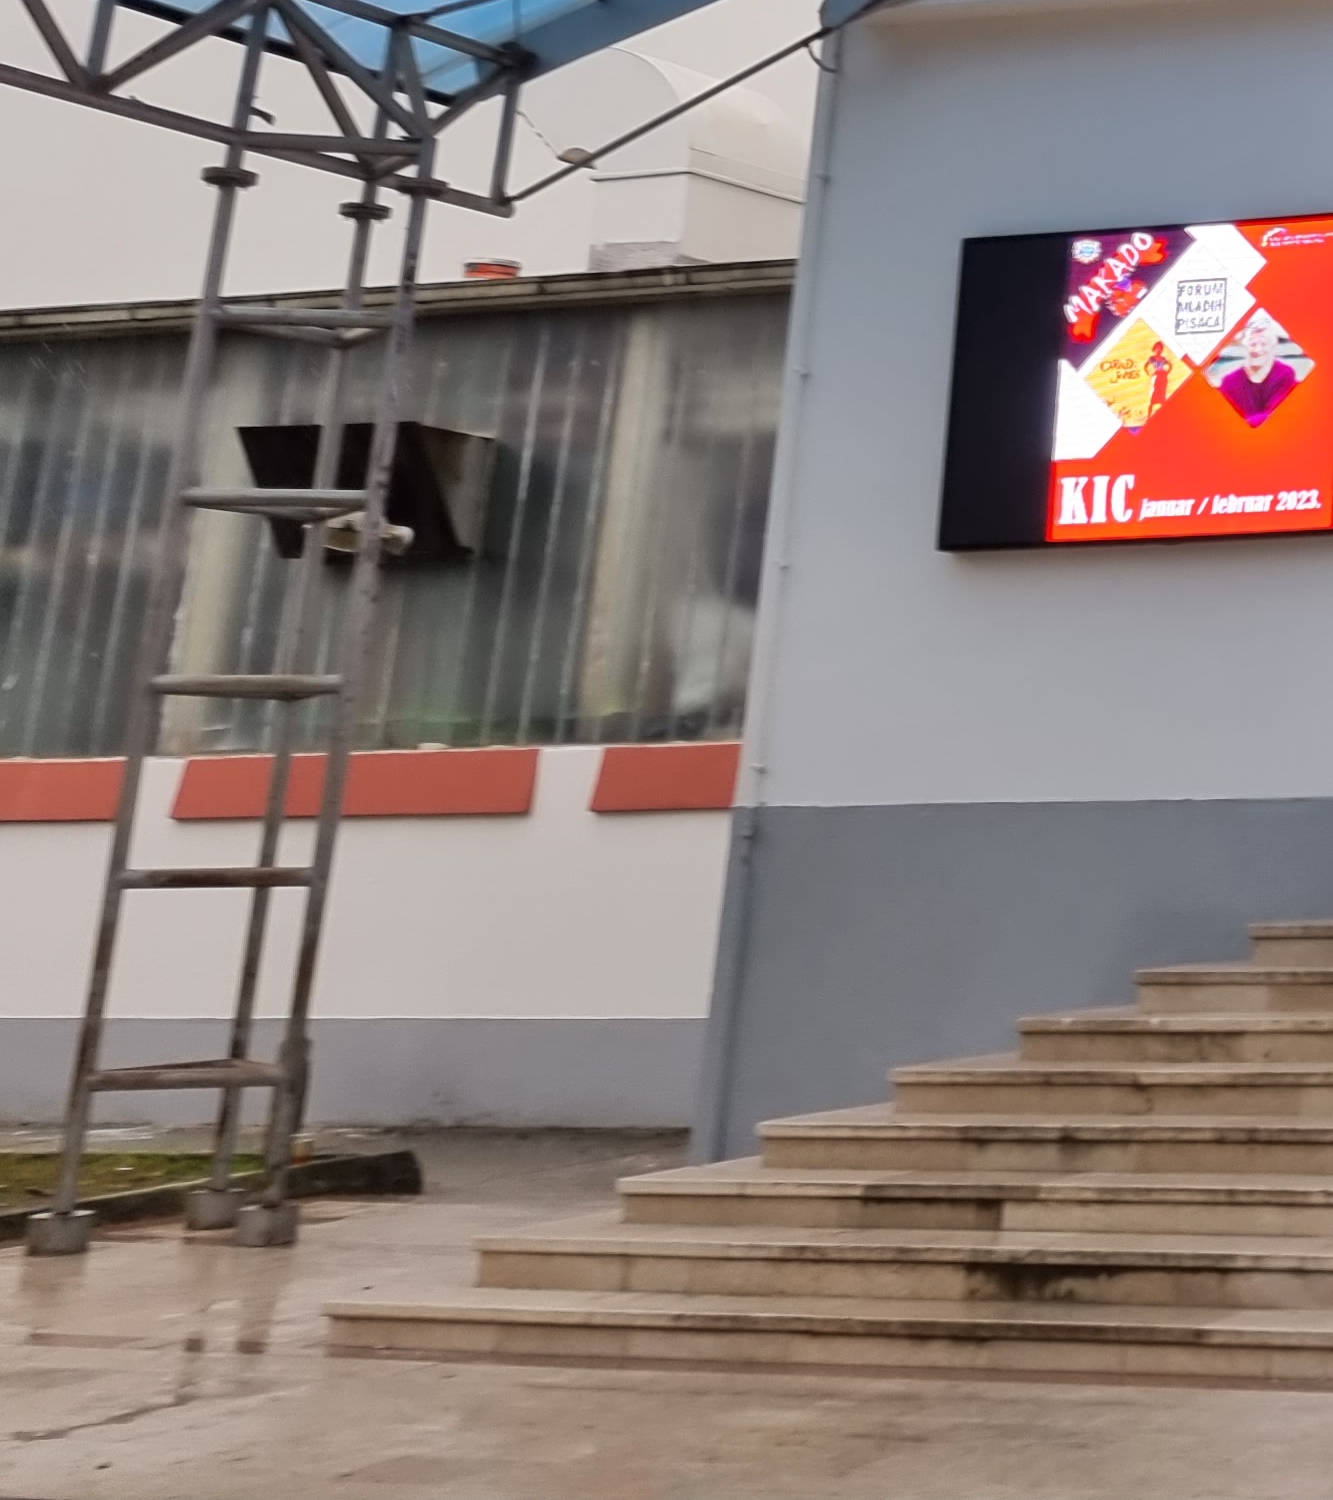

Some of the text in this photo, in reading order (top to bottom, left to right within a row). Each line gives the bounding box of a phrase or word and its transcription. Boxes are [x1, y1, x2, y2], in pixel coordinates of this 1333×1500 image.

[1063, 232, 1153, 323] MAKADO
[1178, 283, 1223, 297] FORUM
[1177, 316, 1220, 330] PISACA
[1058, 474, 1135, 525] KIC
[1139, 498, 1195, 521] januar
[1275, 488, 1322, 512] 2023.
